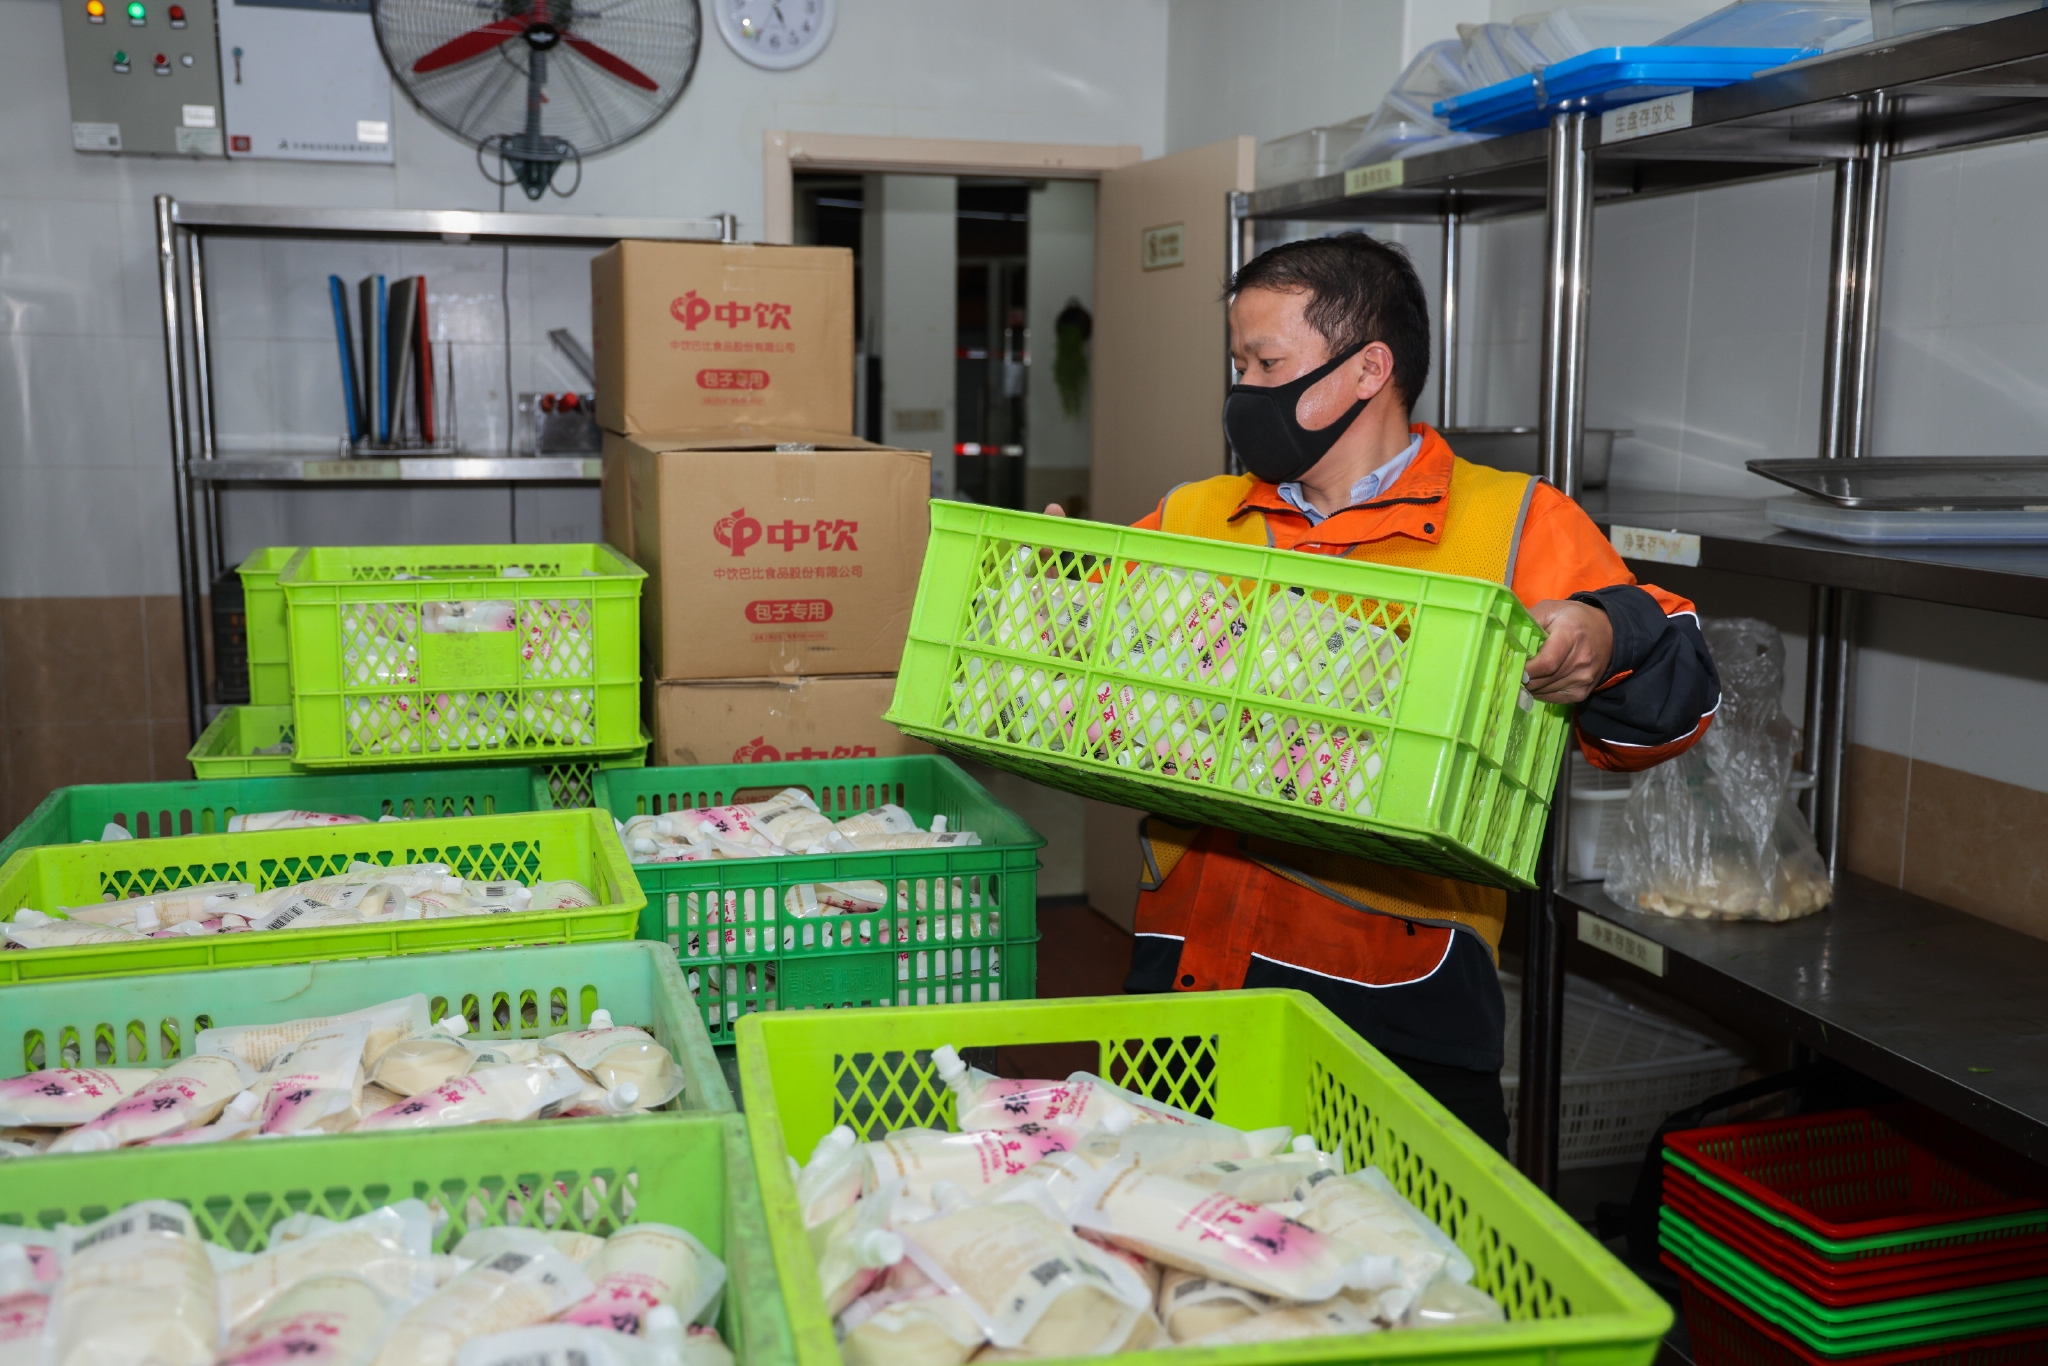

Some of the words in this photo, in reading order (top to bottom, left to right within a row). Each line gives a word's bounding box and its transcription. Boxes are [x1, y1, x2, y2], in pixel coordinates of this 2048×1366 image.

[1615, 100, 1675, 133] 生盘存放处
[714, 301, 792, 331] 中饮
[670, 340, 796, 354] 中饮巴比食品股份有限公司
[703, 372, 764, 388] 包子专用
[766, 519, 859, 552] 中饮
[713, 565, 863, 581] 中饮巴比食品股份有限公司
[754, 602, 826, 621] 包子专用
